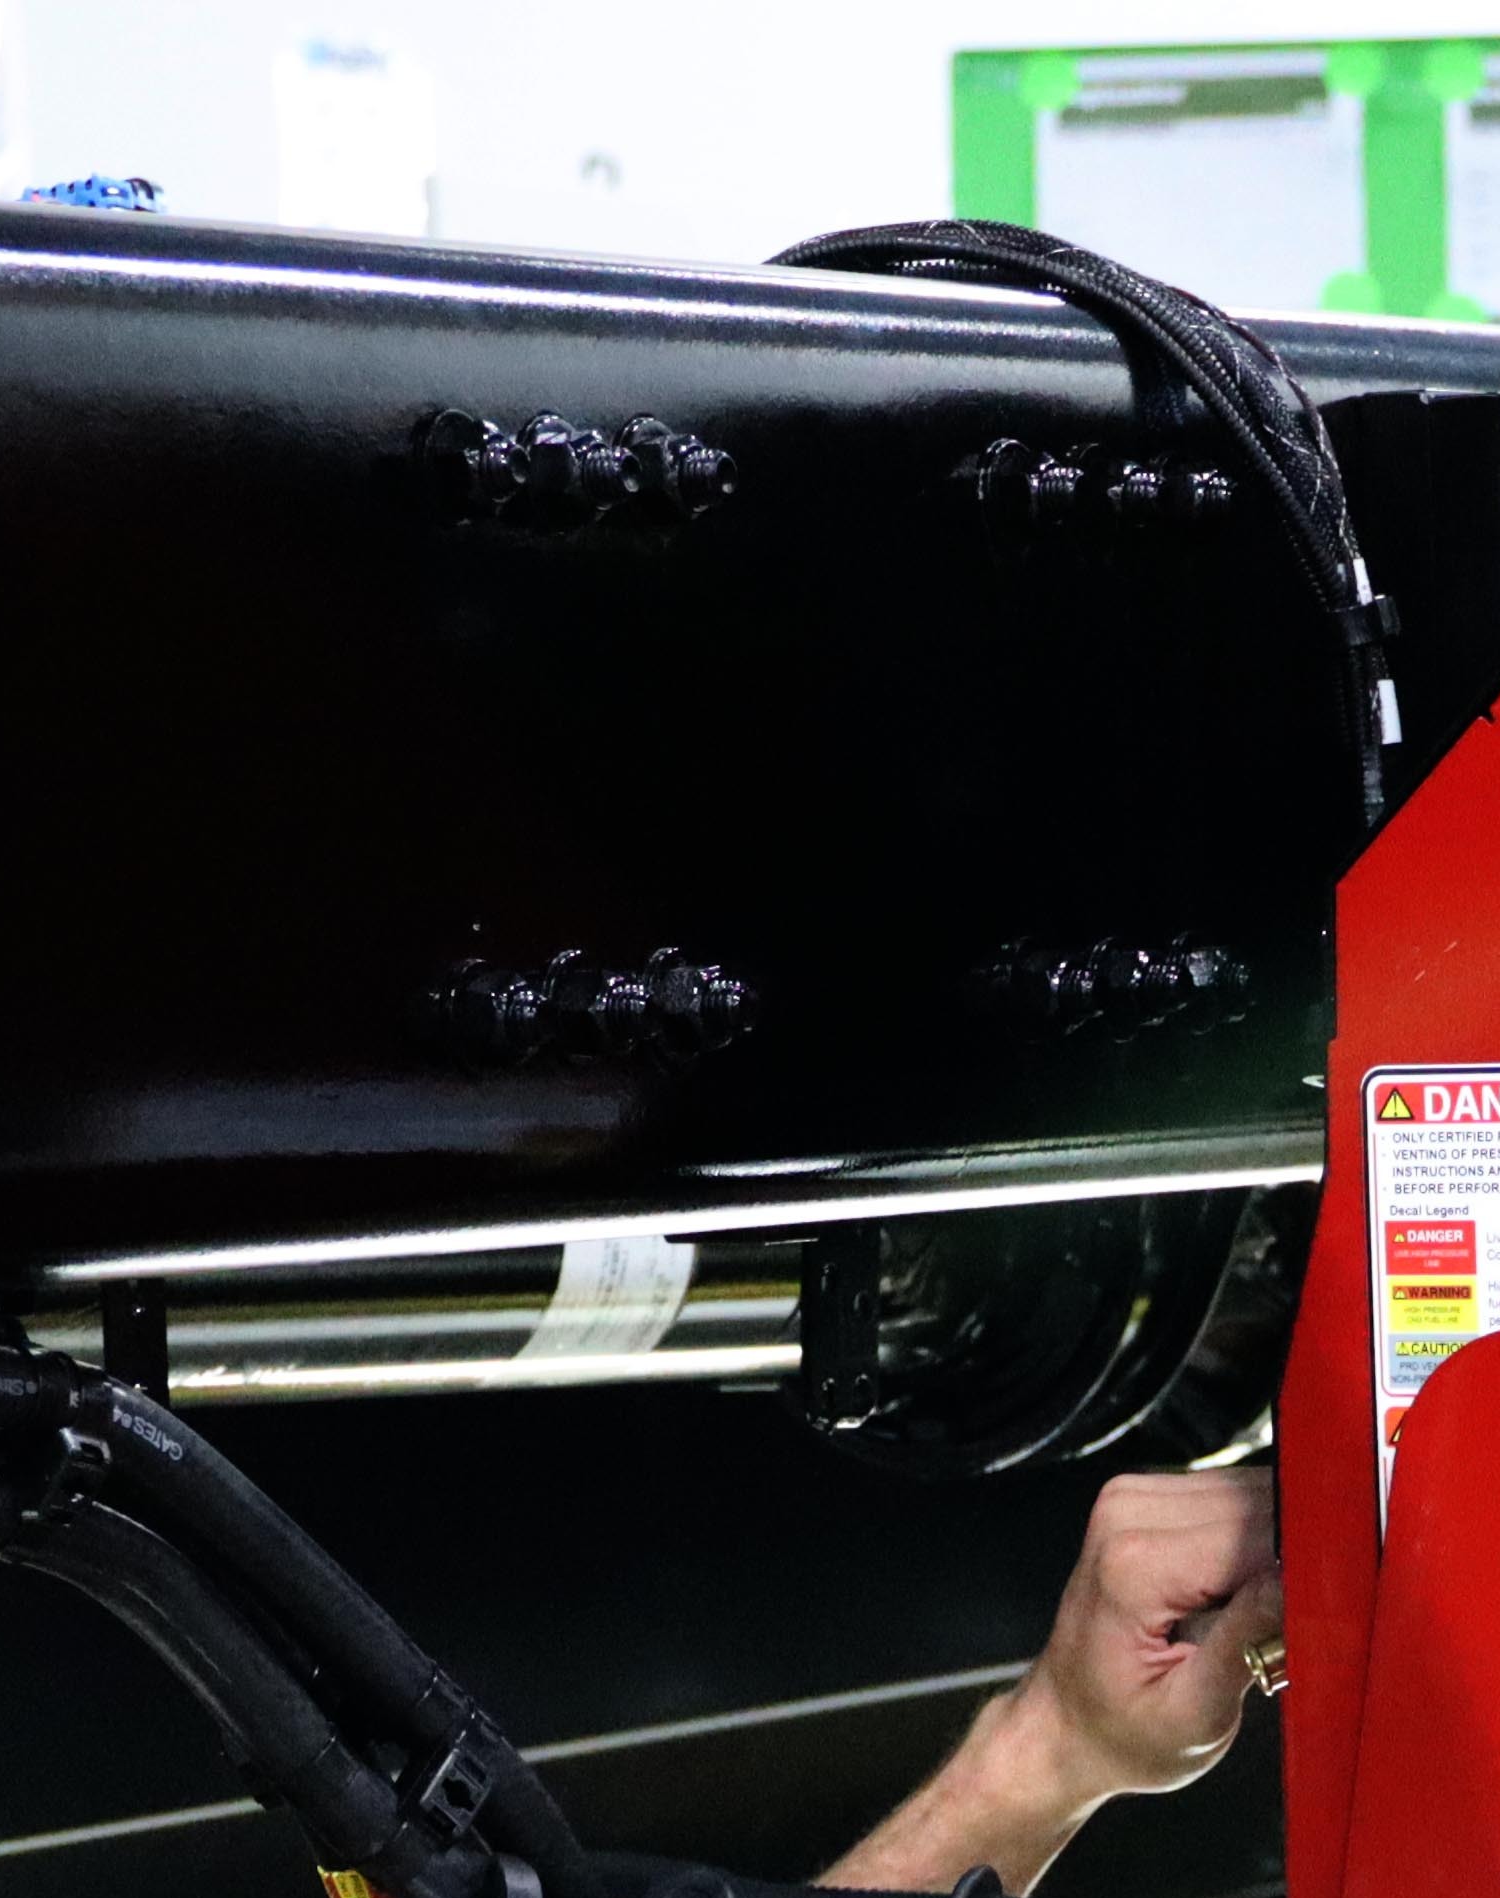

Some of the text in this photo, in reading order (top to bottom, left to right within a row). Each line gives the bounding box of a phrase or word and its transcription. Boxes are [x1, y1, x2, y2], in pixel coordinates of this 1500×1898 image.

[1393, 1132, 1424, 1143] ONLY
[1429, 1131, 1493, 1143] CERTIFIED
[1393, 1149, 1447, 1160] VENTING
[1451, 1149, 1467, 1160] OF
[1393, 1166, 1484, 1177] INSTRUCTIONS
[1395, 1183, 1444, 1194] BEFORE
[1390, 1205, 1469, 1218] Decal Legend
[1407, 1229, 1464, 1243] DANGER
[1408, 1287, 1470, 1298] WARNING
[132, 1415, 184, 1461] GATES
